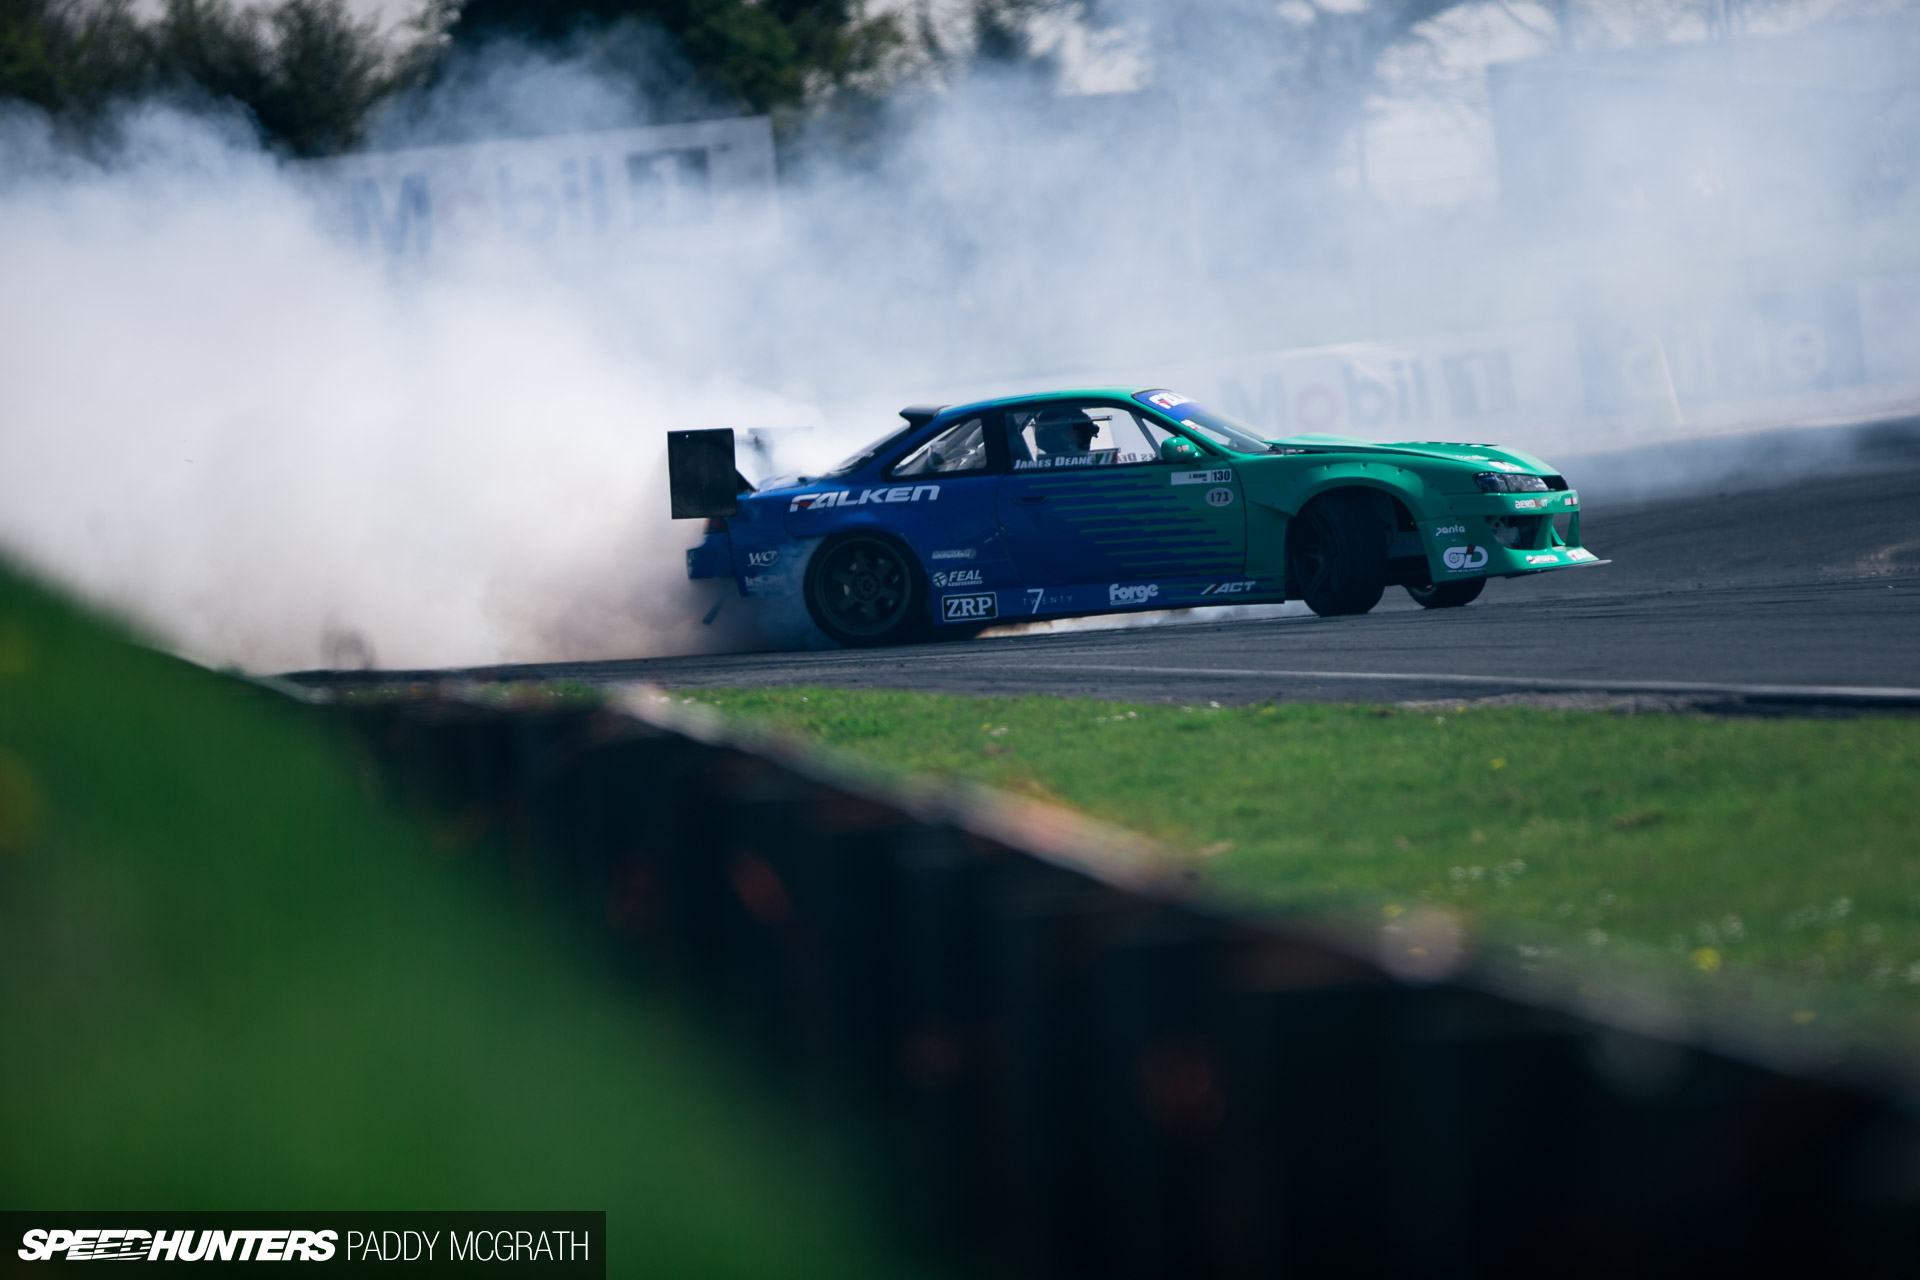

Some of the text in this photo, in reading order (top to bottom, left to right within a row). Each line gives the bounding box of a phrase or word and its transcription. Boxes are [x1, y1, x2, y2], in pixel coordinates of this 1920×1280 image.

[350, 155, 609, 255] Mobil
[1217, 356, 1432, 434] Mobil
[1014, 456, 1094, 470] JAMES DEANE
[1213, 470, 1231, 481] 130
[789, 485, 940, 512] FALKEN
[1211, 491, 1229, 502] 173
[949, 569, 982, 582] FEAL
[1027, 588, 1044, 614] 7
[1109, 583, 1159, 602] Forge
[946, 597, 993, 617] ZRP
